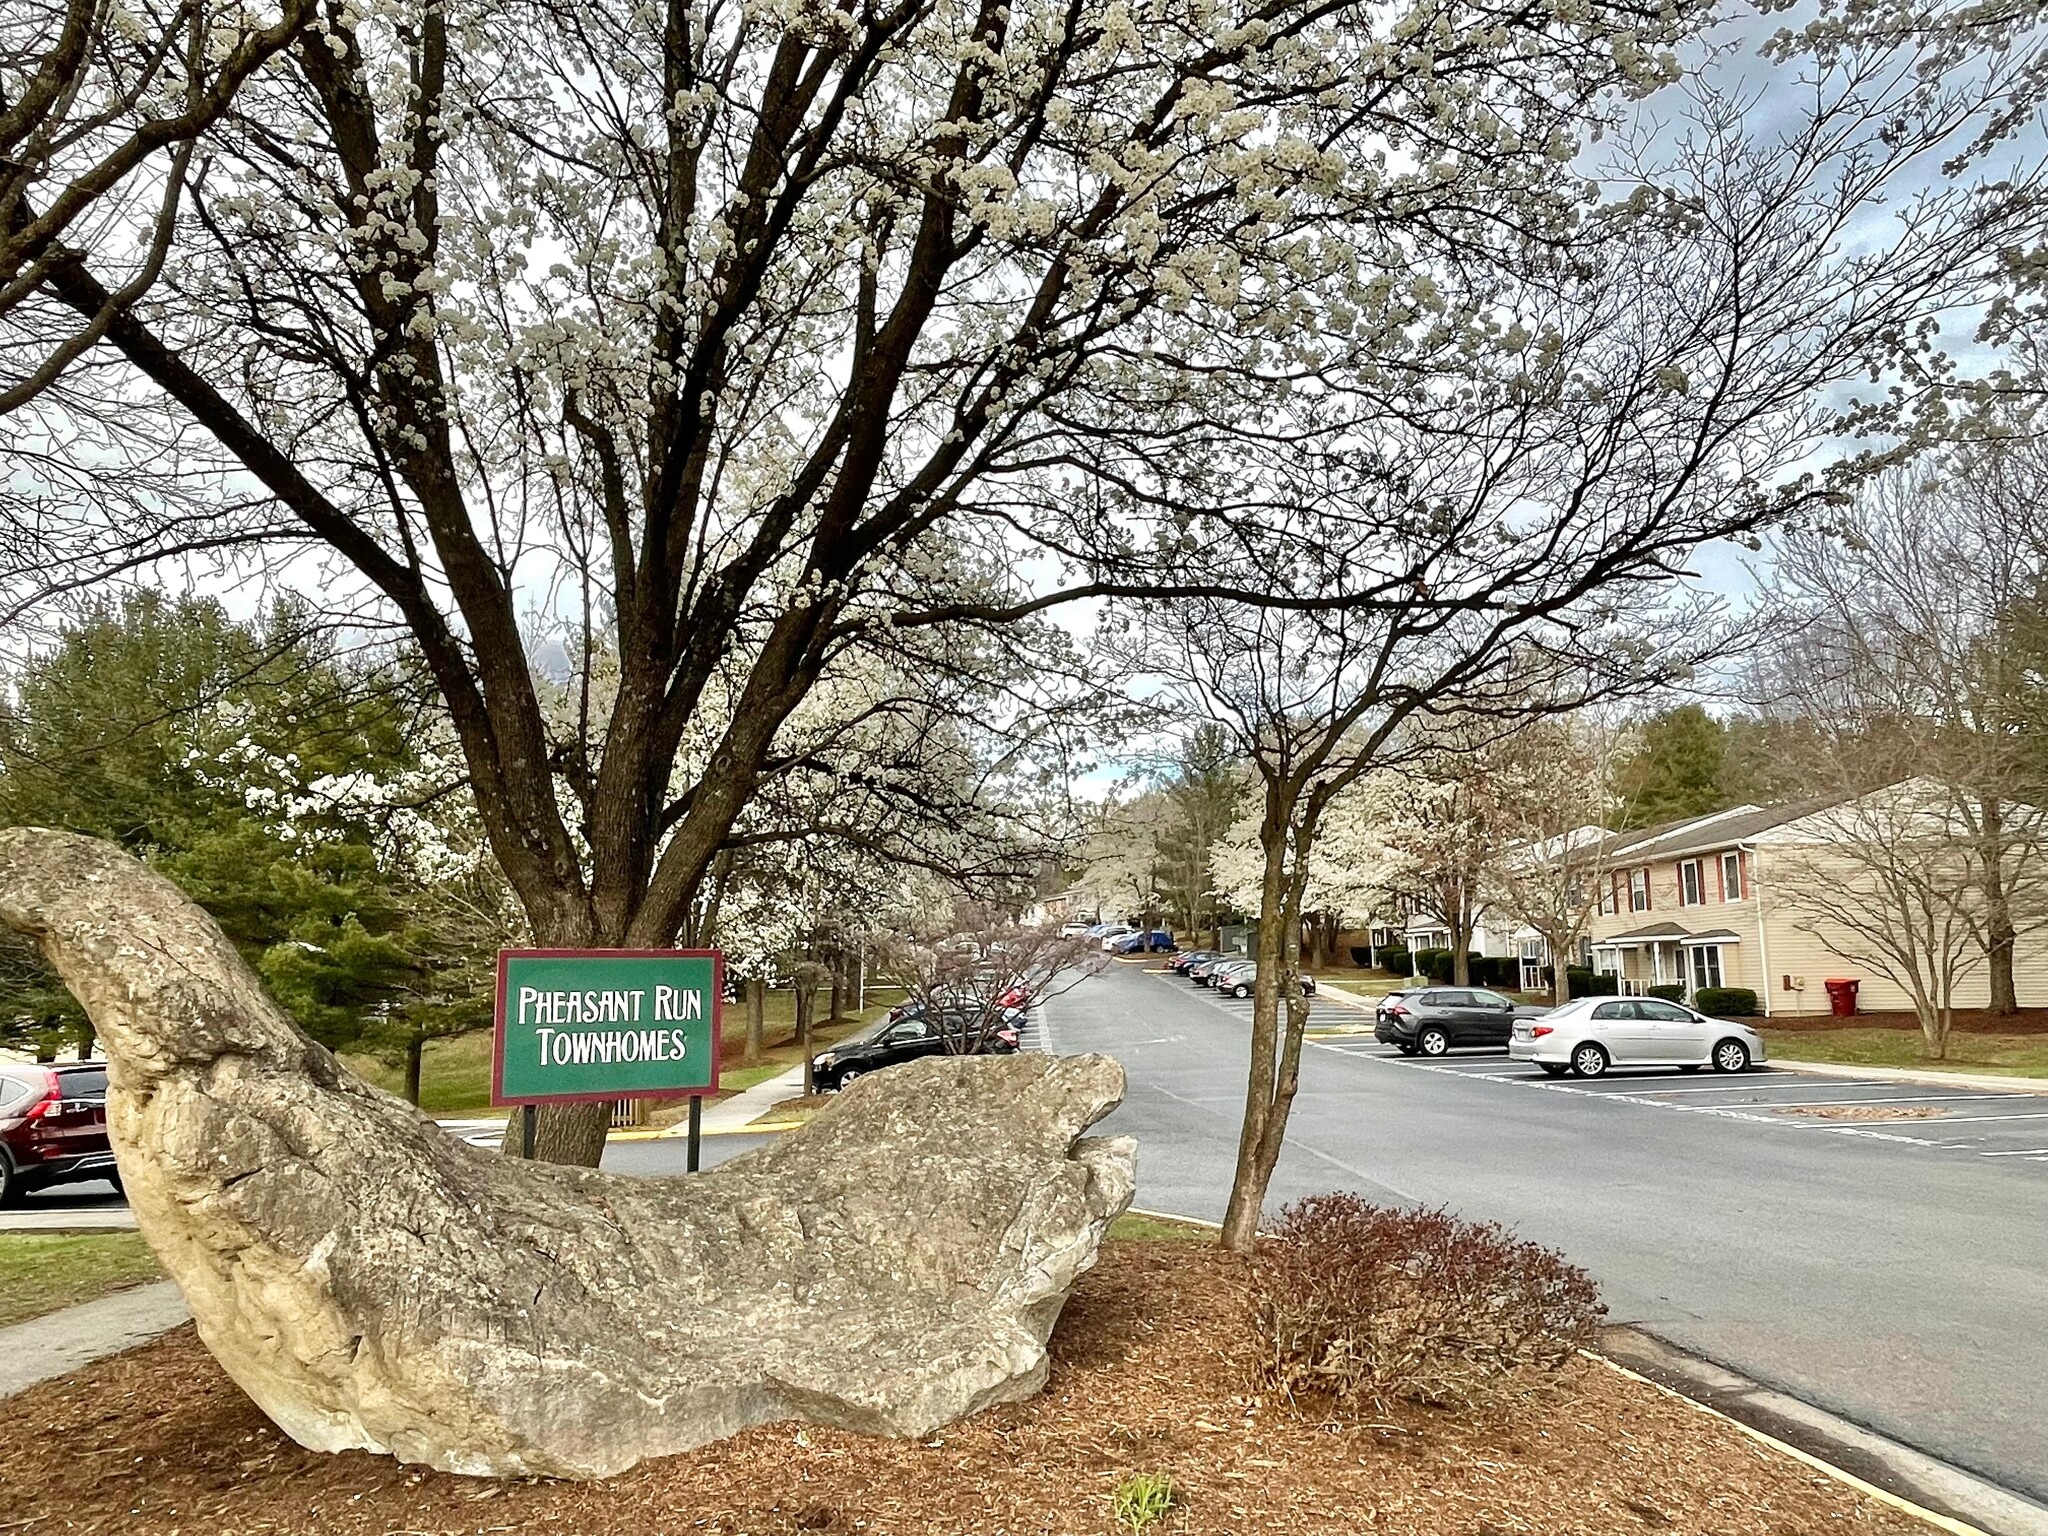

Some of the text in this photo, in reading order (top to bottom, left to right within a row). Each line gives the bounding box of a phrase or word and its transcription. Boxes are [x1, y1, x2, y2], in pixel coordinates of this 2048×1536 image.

[518, 985, 702, 1025] PHEASANT RUN
[535, 1028, 687, 1066] TOWNHOMES
